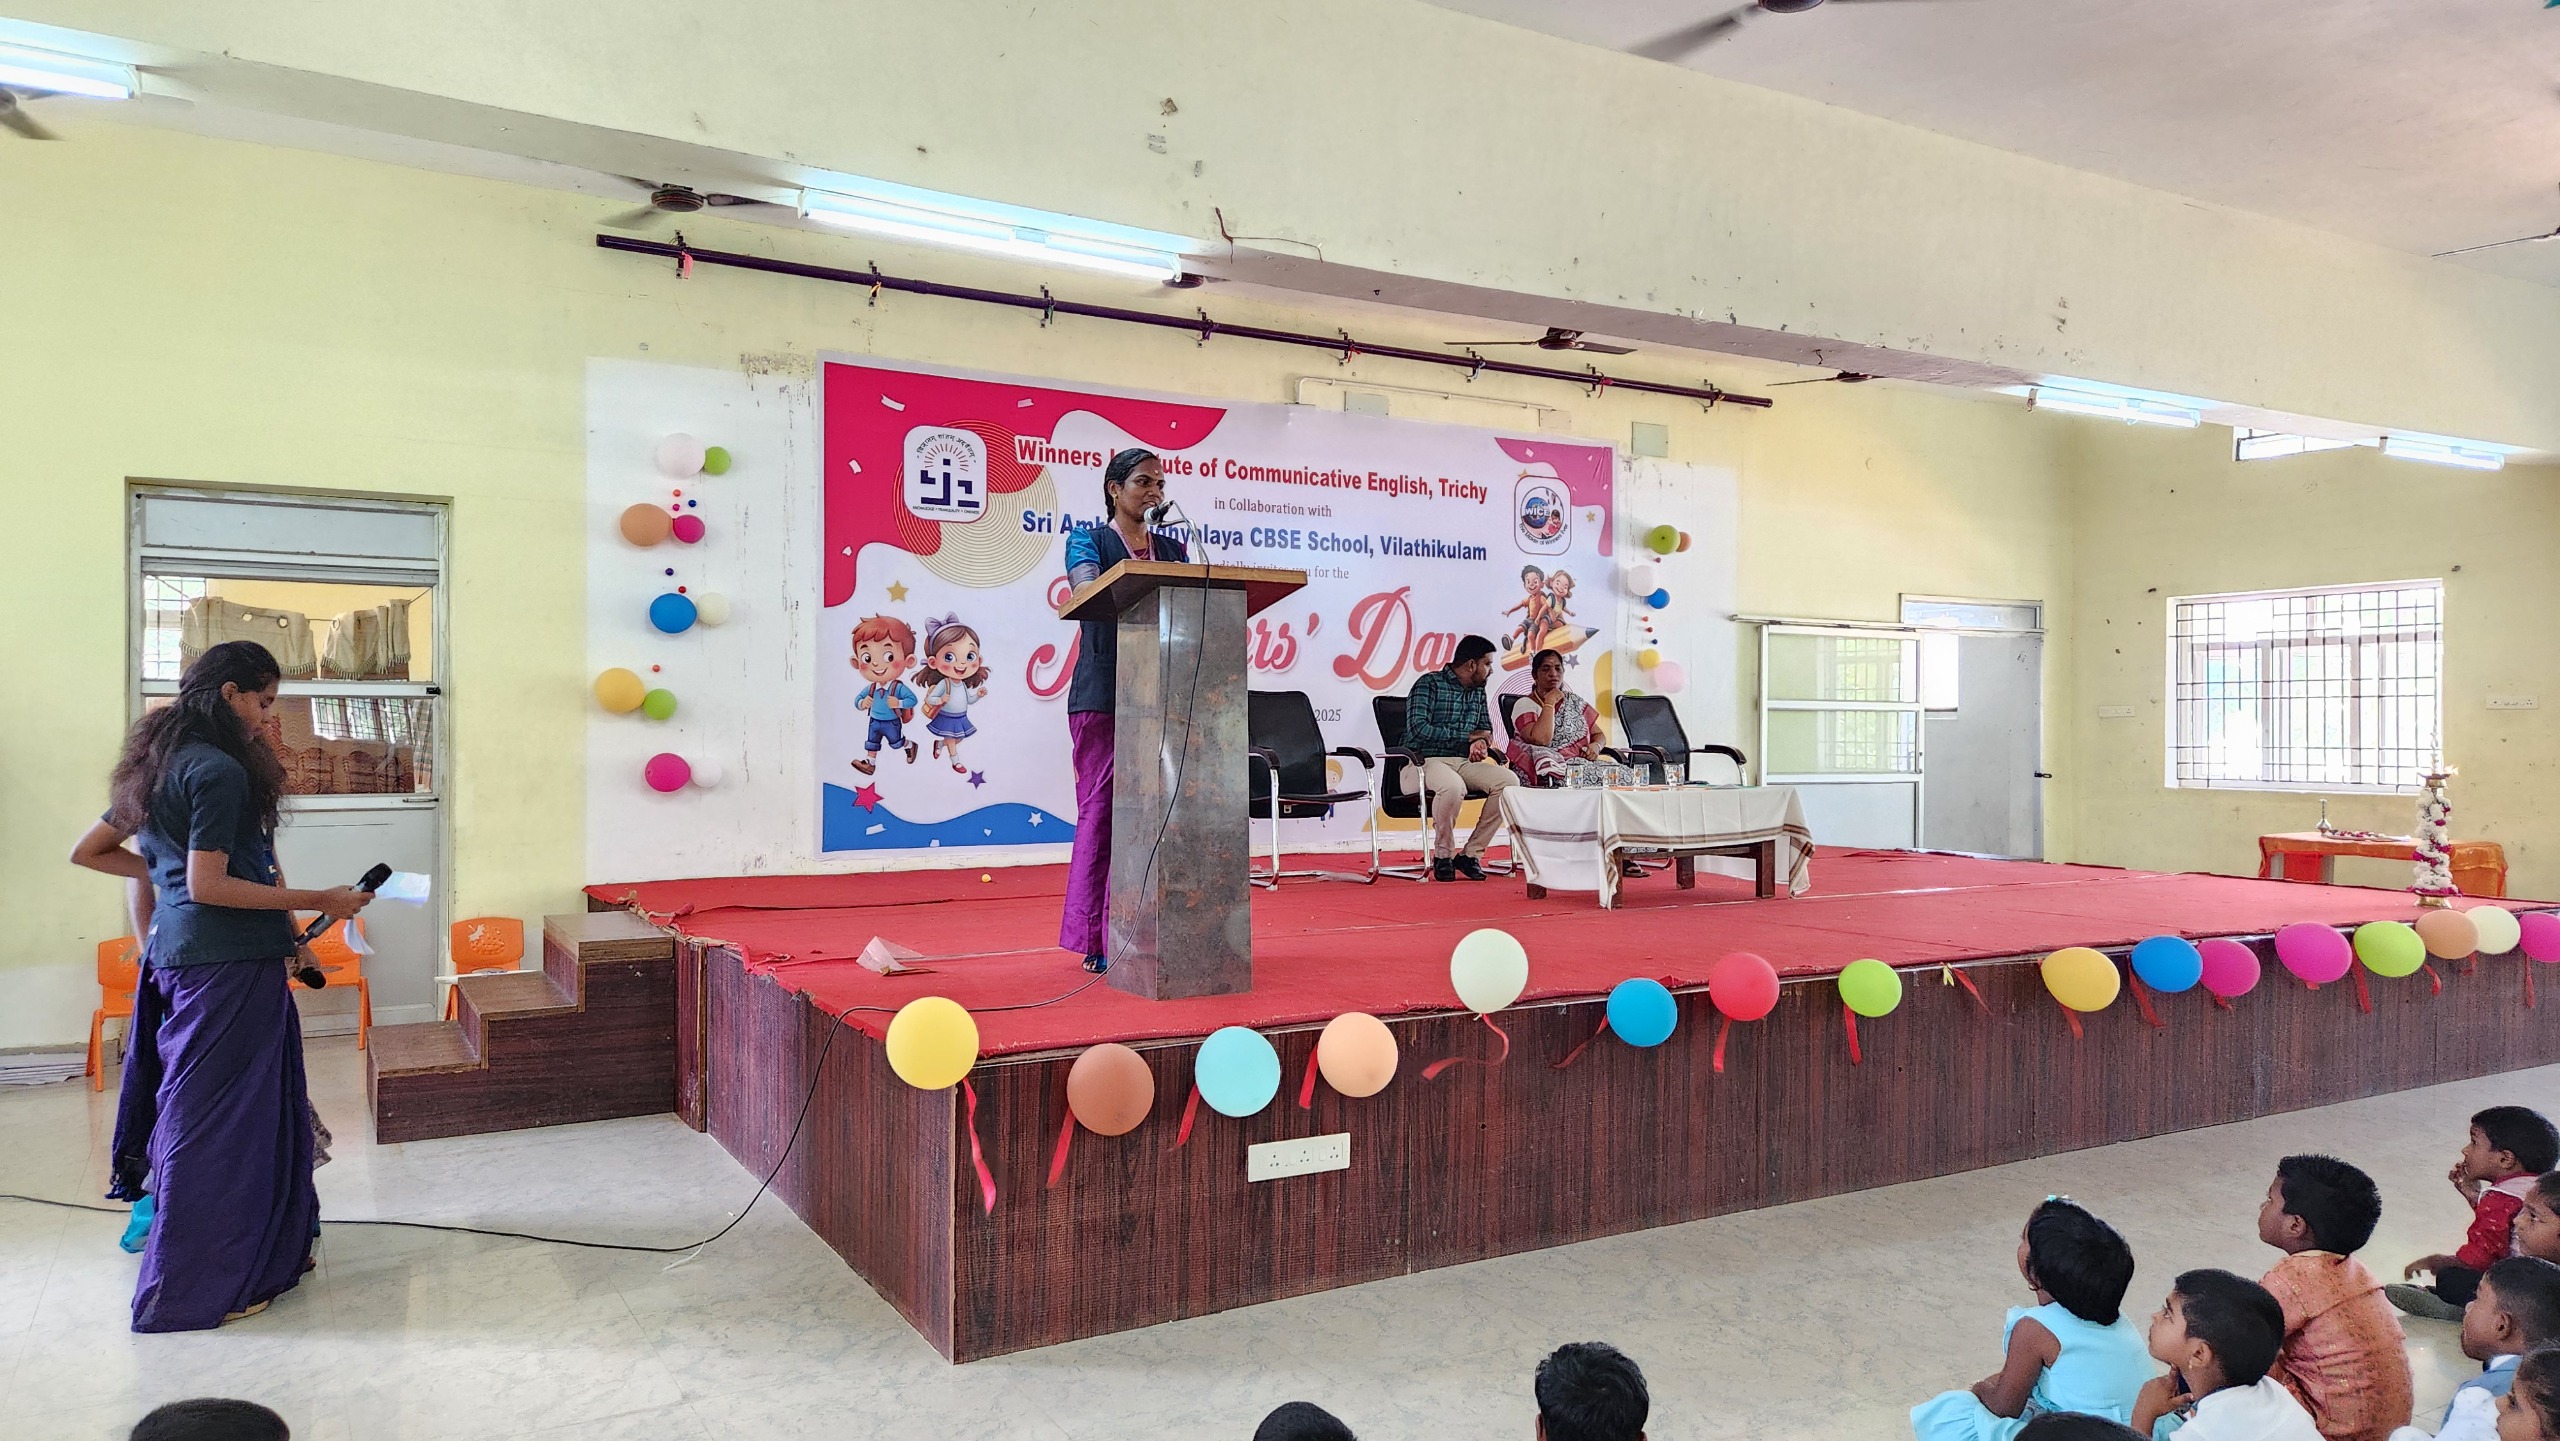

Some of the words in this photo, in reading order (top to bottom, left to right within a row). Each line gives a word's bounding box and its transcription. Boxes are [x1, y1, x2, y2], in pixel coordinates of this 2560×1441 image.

[1018, 438, 1103, 468] Winners
[1199, 457, 1218, 477] of
[1224, 459, 1362, 490] Communicative
[1367, 471, 1433, 499] English,
[1438, 478, 1488, 504] Trichy
[1214, 497, 1225, 510] in
[1228, 498, 1304, 516] Collaboration
[1307, 504, 1332, 518] with
[1526, 507, 1549, 517] WICE
[1022, 510, 1052, 534] Sri
[1250, 526, 1301, 550] CBSE
[1307, 530, 1374, 558] School,
[1380, 535, 1487, 561] Vilathikulam
[1313, 565, 1330, 579] for
[1332, 566, 1349, 579] the
